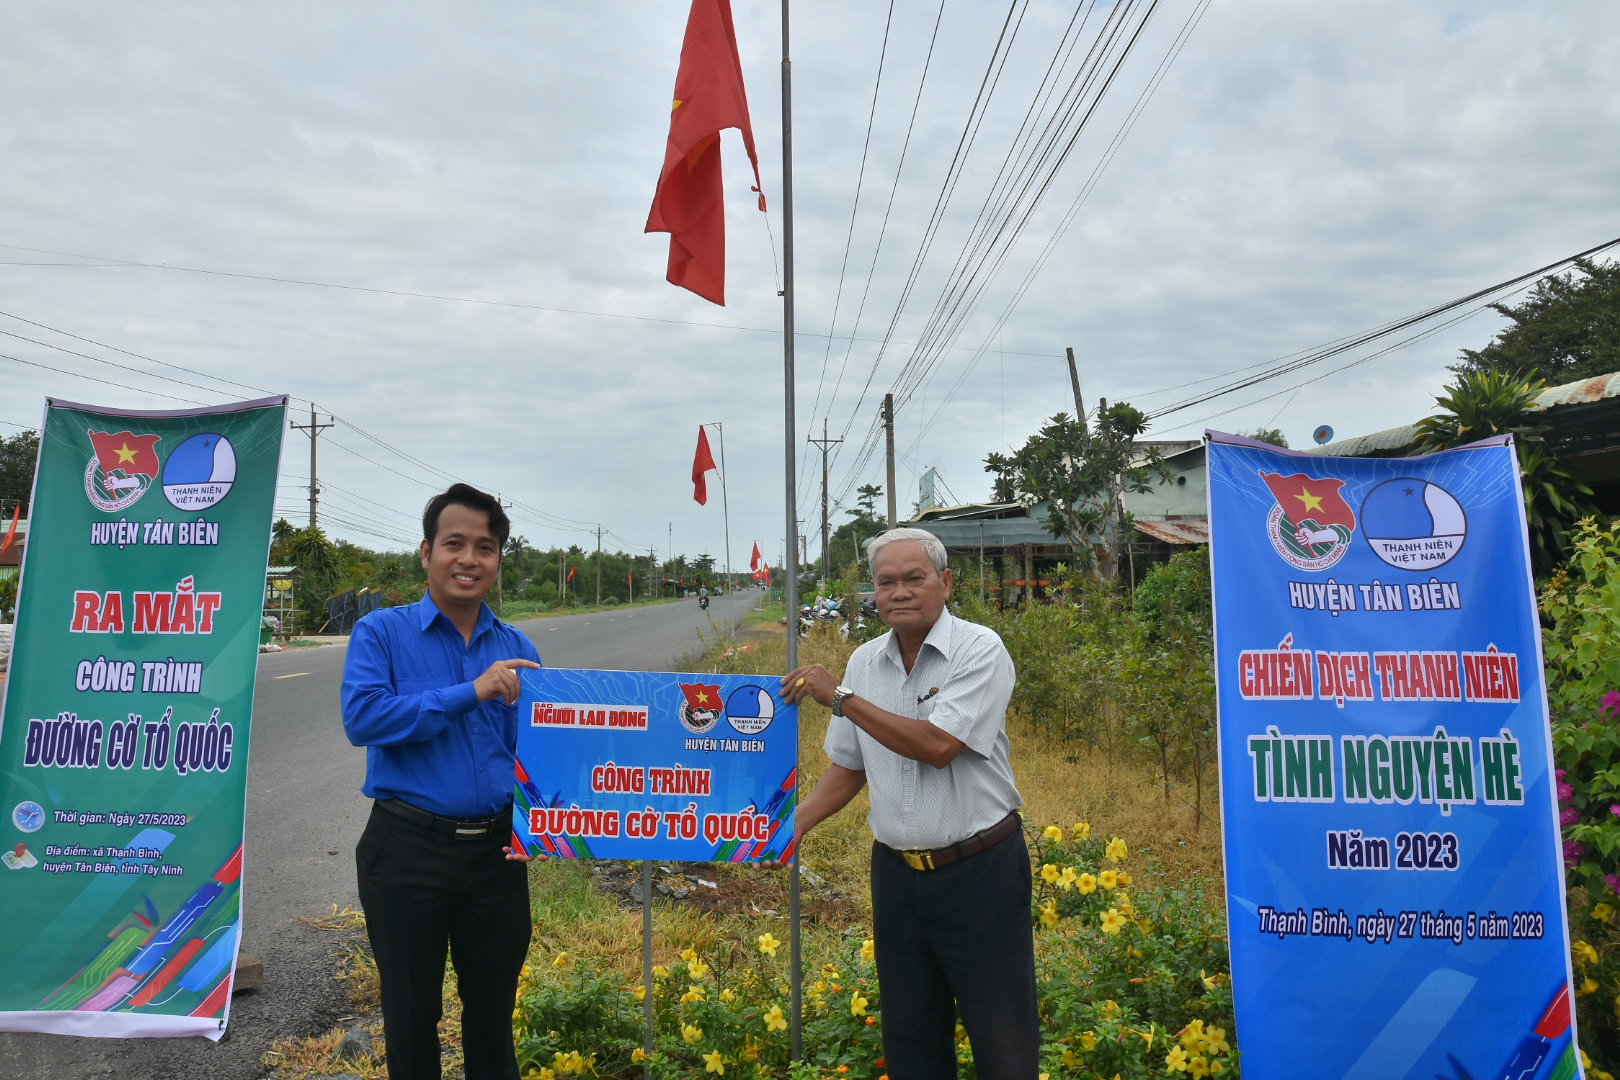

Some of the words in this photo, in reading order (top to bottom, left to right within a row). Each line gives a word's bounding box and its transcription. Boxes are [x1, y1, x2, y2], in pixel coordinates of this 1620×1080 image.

[172, 487, 198, 495] THANH
[201, 485, 222, 494] NIÊN
[176, 496, 193, 505] VIỆT
[91, 518, 140, 549] HUYỆN
[143, 518, 175, 545] TÂN
[178, 518, 219, 545] BIÊN
[1382, 543, 1421, 552] THANH
[1425, 539, 1453, 550] NIÊN
[1391, 553, 1416, 563] VIỆT
[1420, 552, 1446, 560] NAM
[70, 590, 124, 633] RA
[132, 575, 221, 634] MẮT
[1288, 578, 1356, 617] HUYỆN
[1359, 579, 1403, 611] TÂN
[1406, 577, 1462, 611] BIÊN
[75, 655, 136, 692] CÔNG
[142, 657, 202, 693] TRÌNH
[1238, 632, 1314, 700] CHIẾN
[1316, 651, 1374, 708] DỊCH
[1374, 651, 1462, 702] THANH
[1462, 642, 1520, 703] NIÊN
[579, 710, 605, 726] LAO
[608, 710, 647, 727] ĐỘNG
[24, 712, 103, 769] ĐƯỜNG
[106, 713, 141, 770] CỜ
[142, 706, 173, 770] TỔ
[174, 708, 234, 776] QUỐC
[685, 737, 717, 753] HUYỆN
[719, 737, 740, 752] TÂN
[741, 738, 765, 752] BIÊN
[592, 761, 644, 795] CÔNG
[649, 762, 711, 796] TRÌNH
[1247, 725, 1336, 802] TÌNH
[1341, 725, 1476, 816] NGUYỆN
[1479, 727, 1524, 806] HÈ
[54, 811, 77, 823] Thời
[79, 812, 106, 825] gian:
[108, 812, 136, 827] Ngày
[138, 813, 187, 826] 27/5/2023
[528, 804, 619, 838] ĐƯỜNG
[625, 806, 660, 839] CỜ
[664, 802, 698, 841] TỔ
[704, 806, 769, 846] QUỐC
[45, 845, 61, 857] Địa
[64, 843, 90, 856] điểm:
[92, 846, 103, 857] xã
[106, 847, 135, 859] Thạnh
[137, 847, 162, 860] Bình,
[1327, 829, 1390, 870] Năm
[1395, 831, 1459, 871] 2023
[42, 861, 72, 875] huyện
[75, 862, 92, 873] Tân
[95, 862, 119, 875] Biên,
[121, 862, 140, 873] tỉnh
[142, 864, 159, 877] Tây
[161, 865, 183, 876] Ninh
[1258, 906, 1307, 938] Thạnh
[1311, 909, 1352, 941] Bình,
[1357, 913, 1395, 942] ngày
[1399, 913, 1416, 937] 27
[1420, 912, 1463, 943] tháng
[1466, 914, 1475, 938] 5
[1479, 912, 1509, 938] năm
[1512, 914, 1544, 939] 2023
